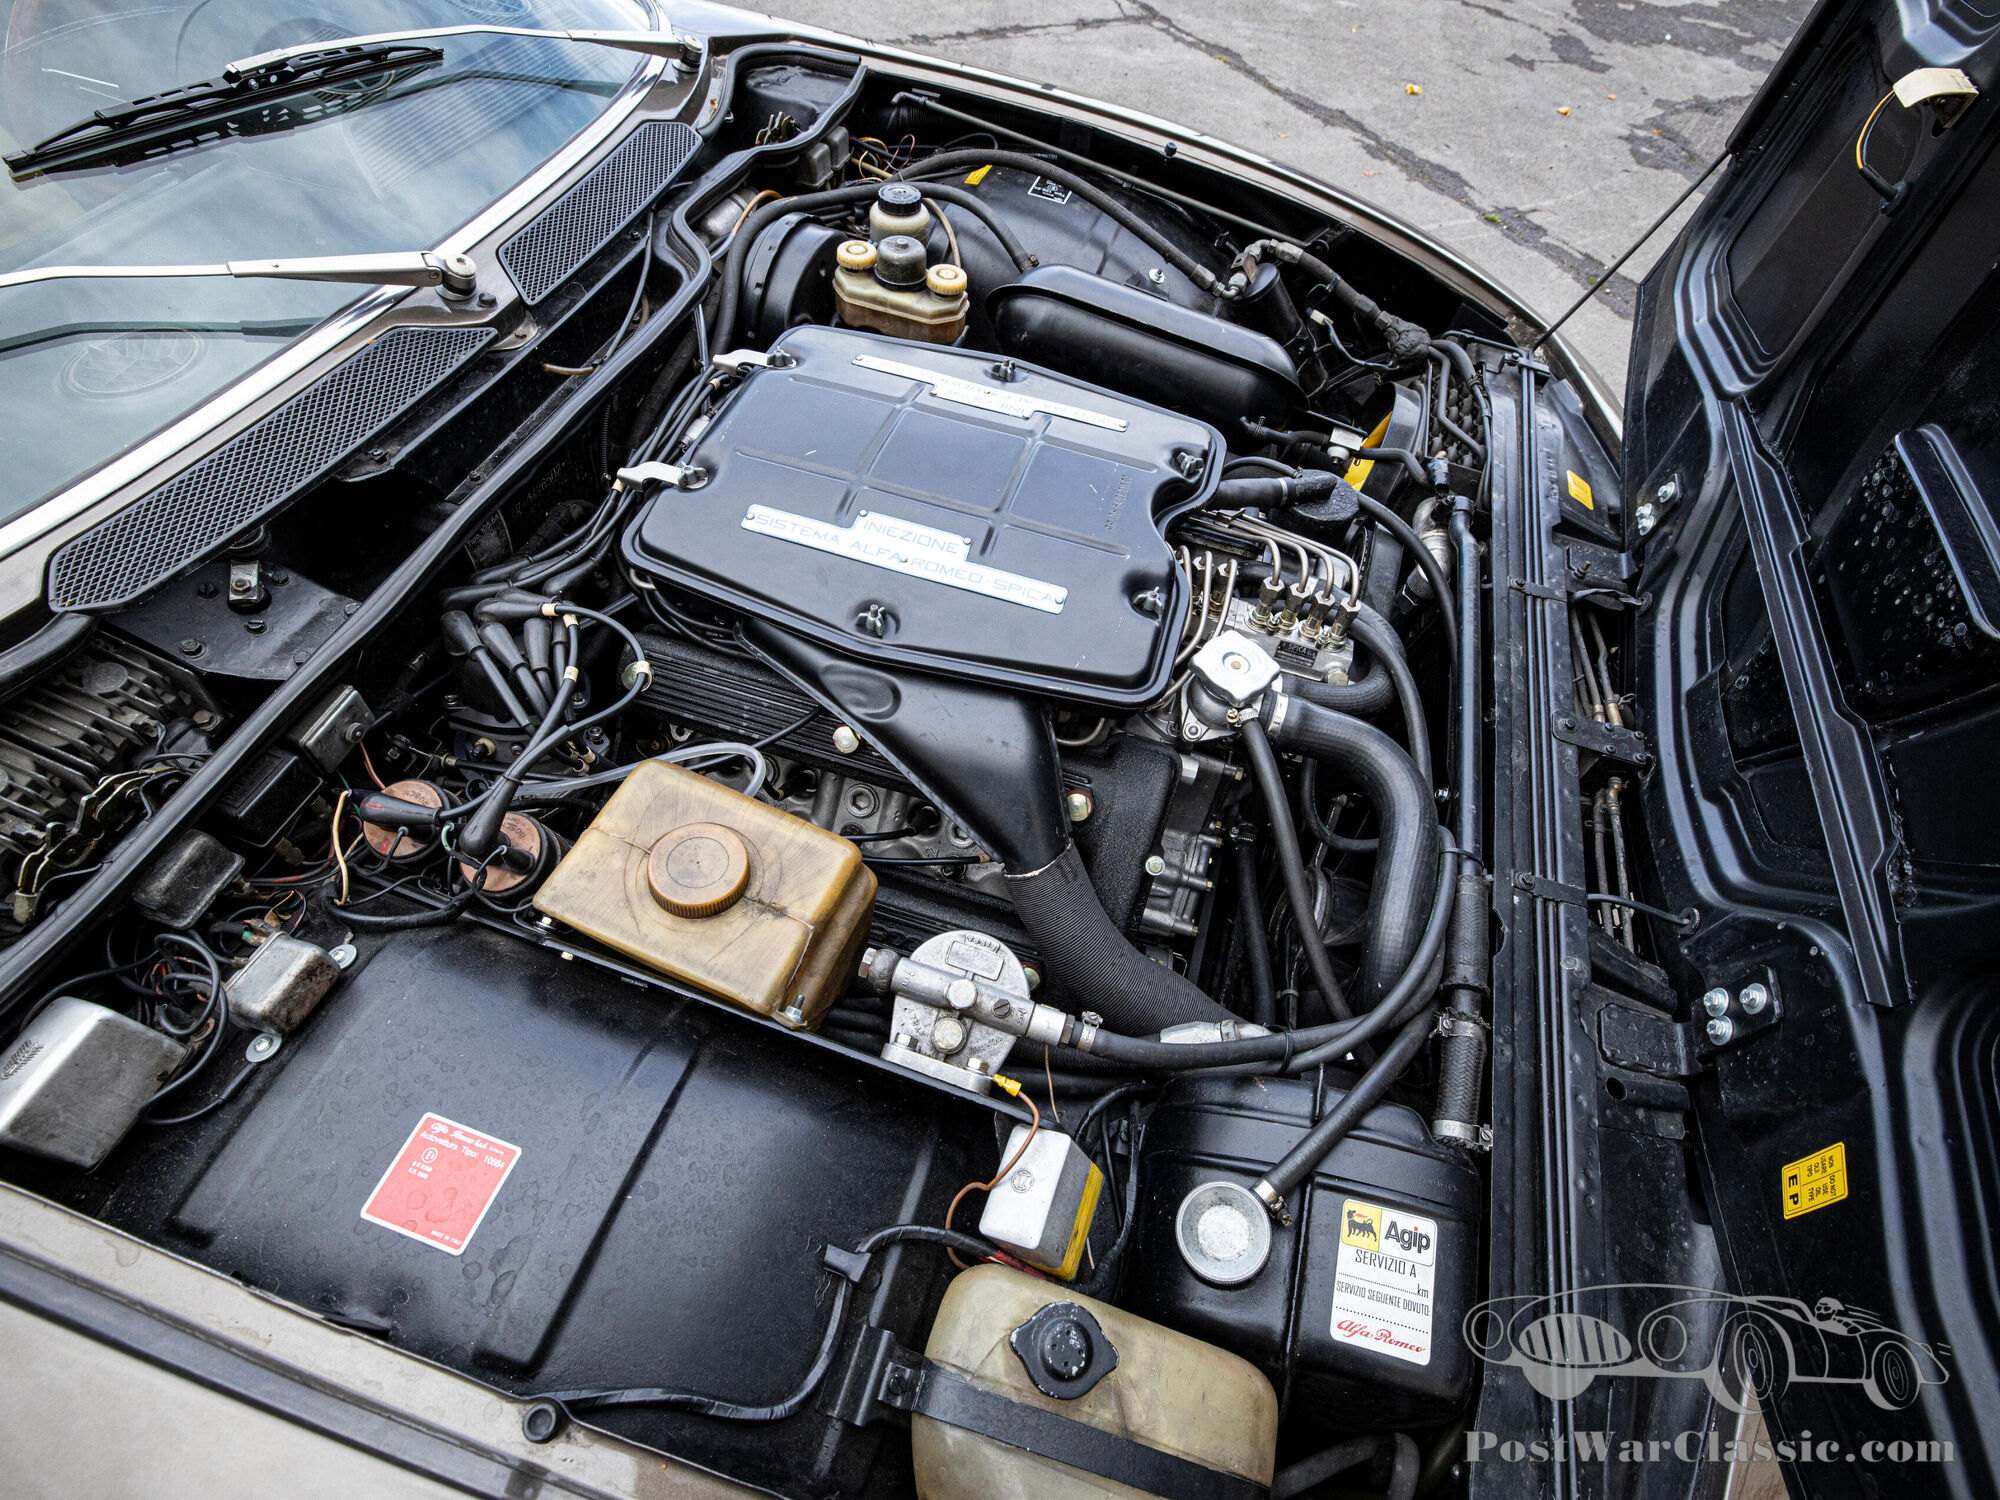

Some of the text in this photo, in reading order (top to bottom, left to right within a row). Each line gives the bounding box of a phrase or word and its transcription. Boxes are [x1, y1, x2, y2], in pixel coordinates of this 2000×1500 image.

[863, 520, 958, 554] INIEZIONE
[754, 514, 1055, 604] SISTEMA ALFA ROMEO SPICA
[1788, 1174, 1799, 1205] E P
[1384, 1220, 1431, 1253] Agip
[1355, 1249, 1417, 1278] SERVIZIO A
[1336, 1281, 1431, 1317] SERVIZIO SEGUENTE DOVUTO:
[1417, 1284, 1429, 1298] km
[1337, 1319, 1426, 1353] Alfa Romeo
